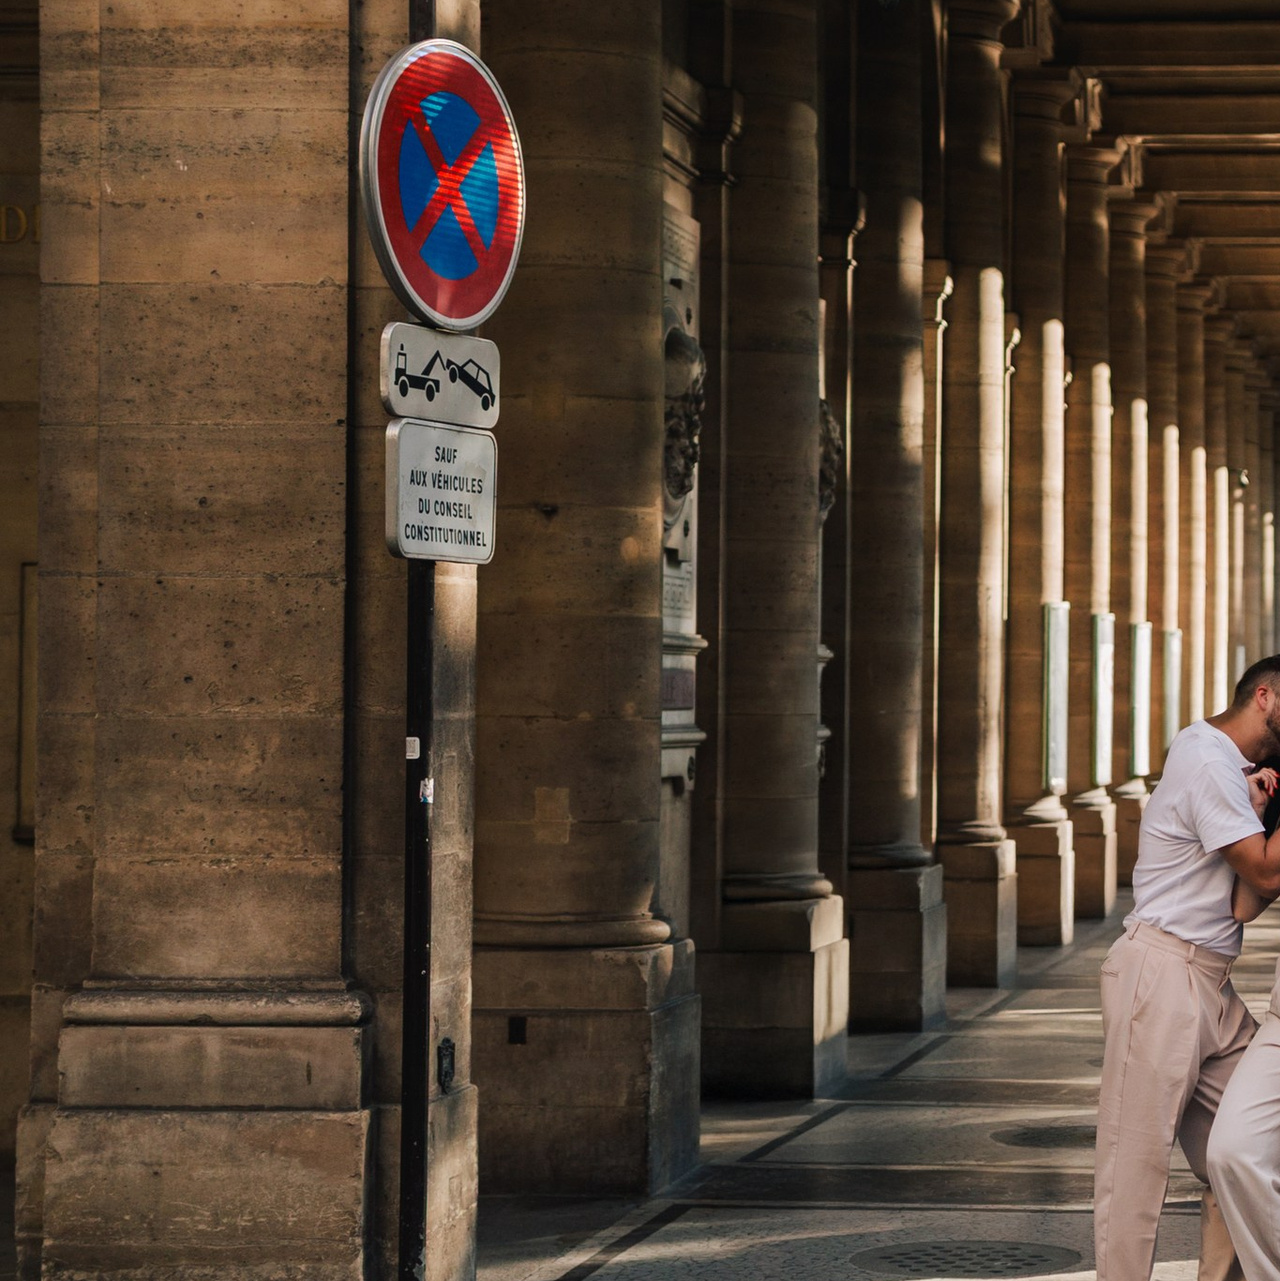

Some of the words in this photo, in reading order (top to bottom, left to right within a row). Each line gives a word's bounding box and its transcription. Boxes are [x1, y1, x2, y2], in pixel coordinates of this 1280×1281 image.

[434, 445, 458, 464] SAUF
[409, 469, 428, 487] AUX
[431, 470, 483, 494] VÉHICULES
[418, 497, 431, 515] DU
[434, 498, 473, 520] CONSEIL
[404, 523, 487, 547] CONSTITUTIONNEL
